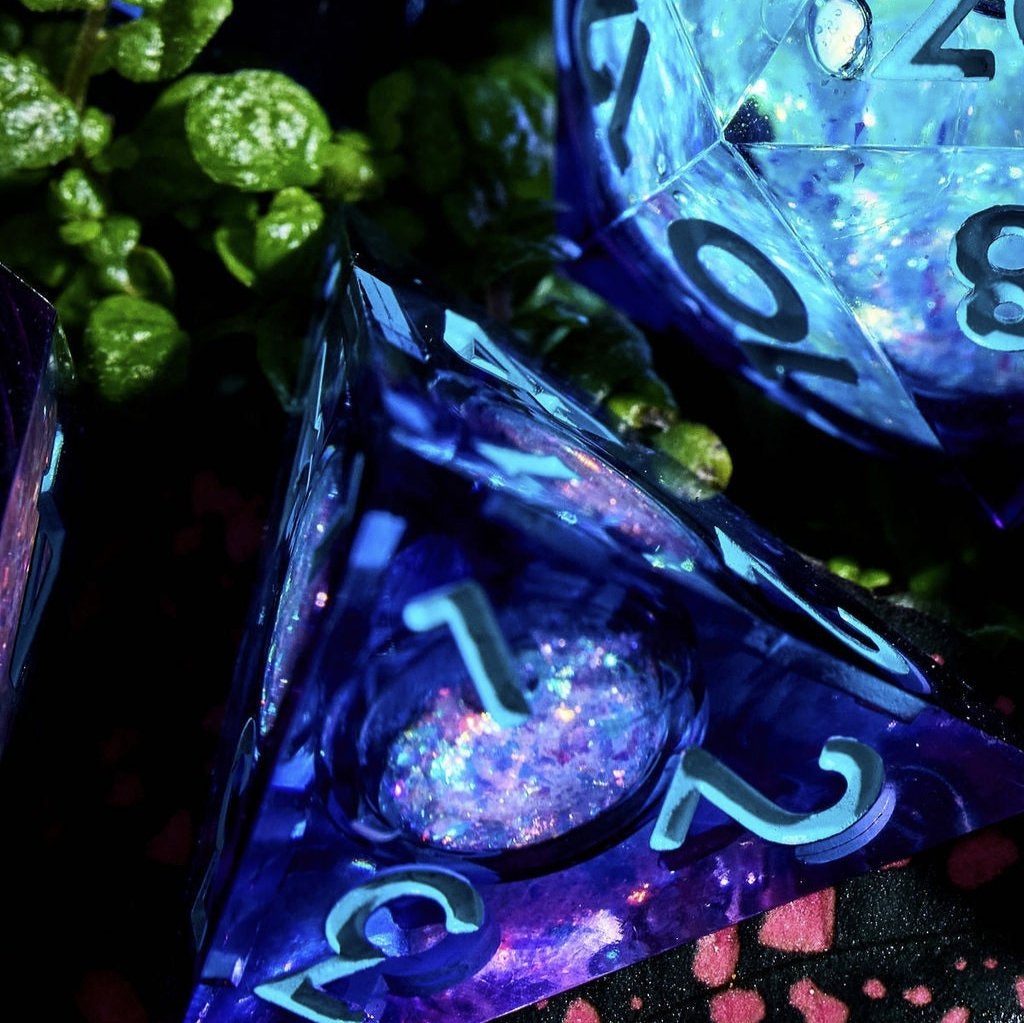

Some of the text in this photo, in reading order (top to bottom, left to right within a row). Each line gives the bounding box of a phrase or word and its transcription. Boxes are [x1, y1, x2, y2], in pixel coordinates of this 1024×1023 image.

[667, 217, 859, 386] 10
[403, 580, 532, 727] 1
[649, 736, 890, 858] 2
